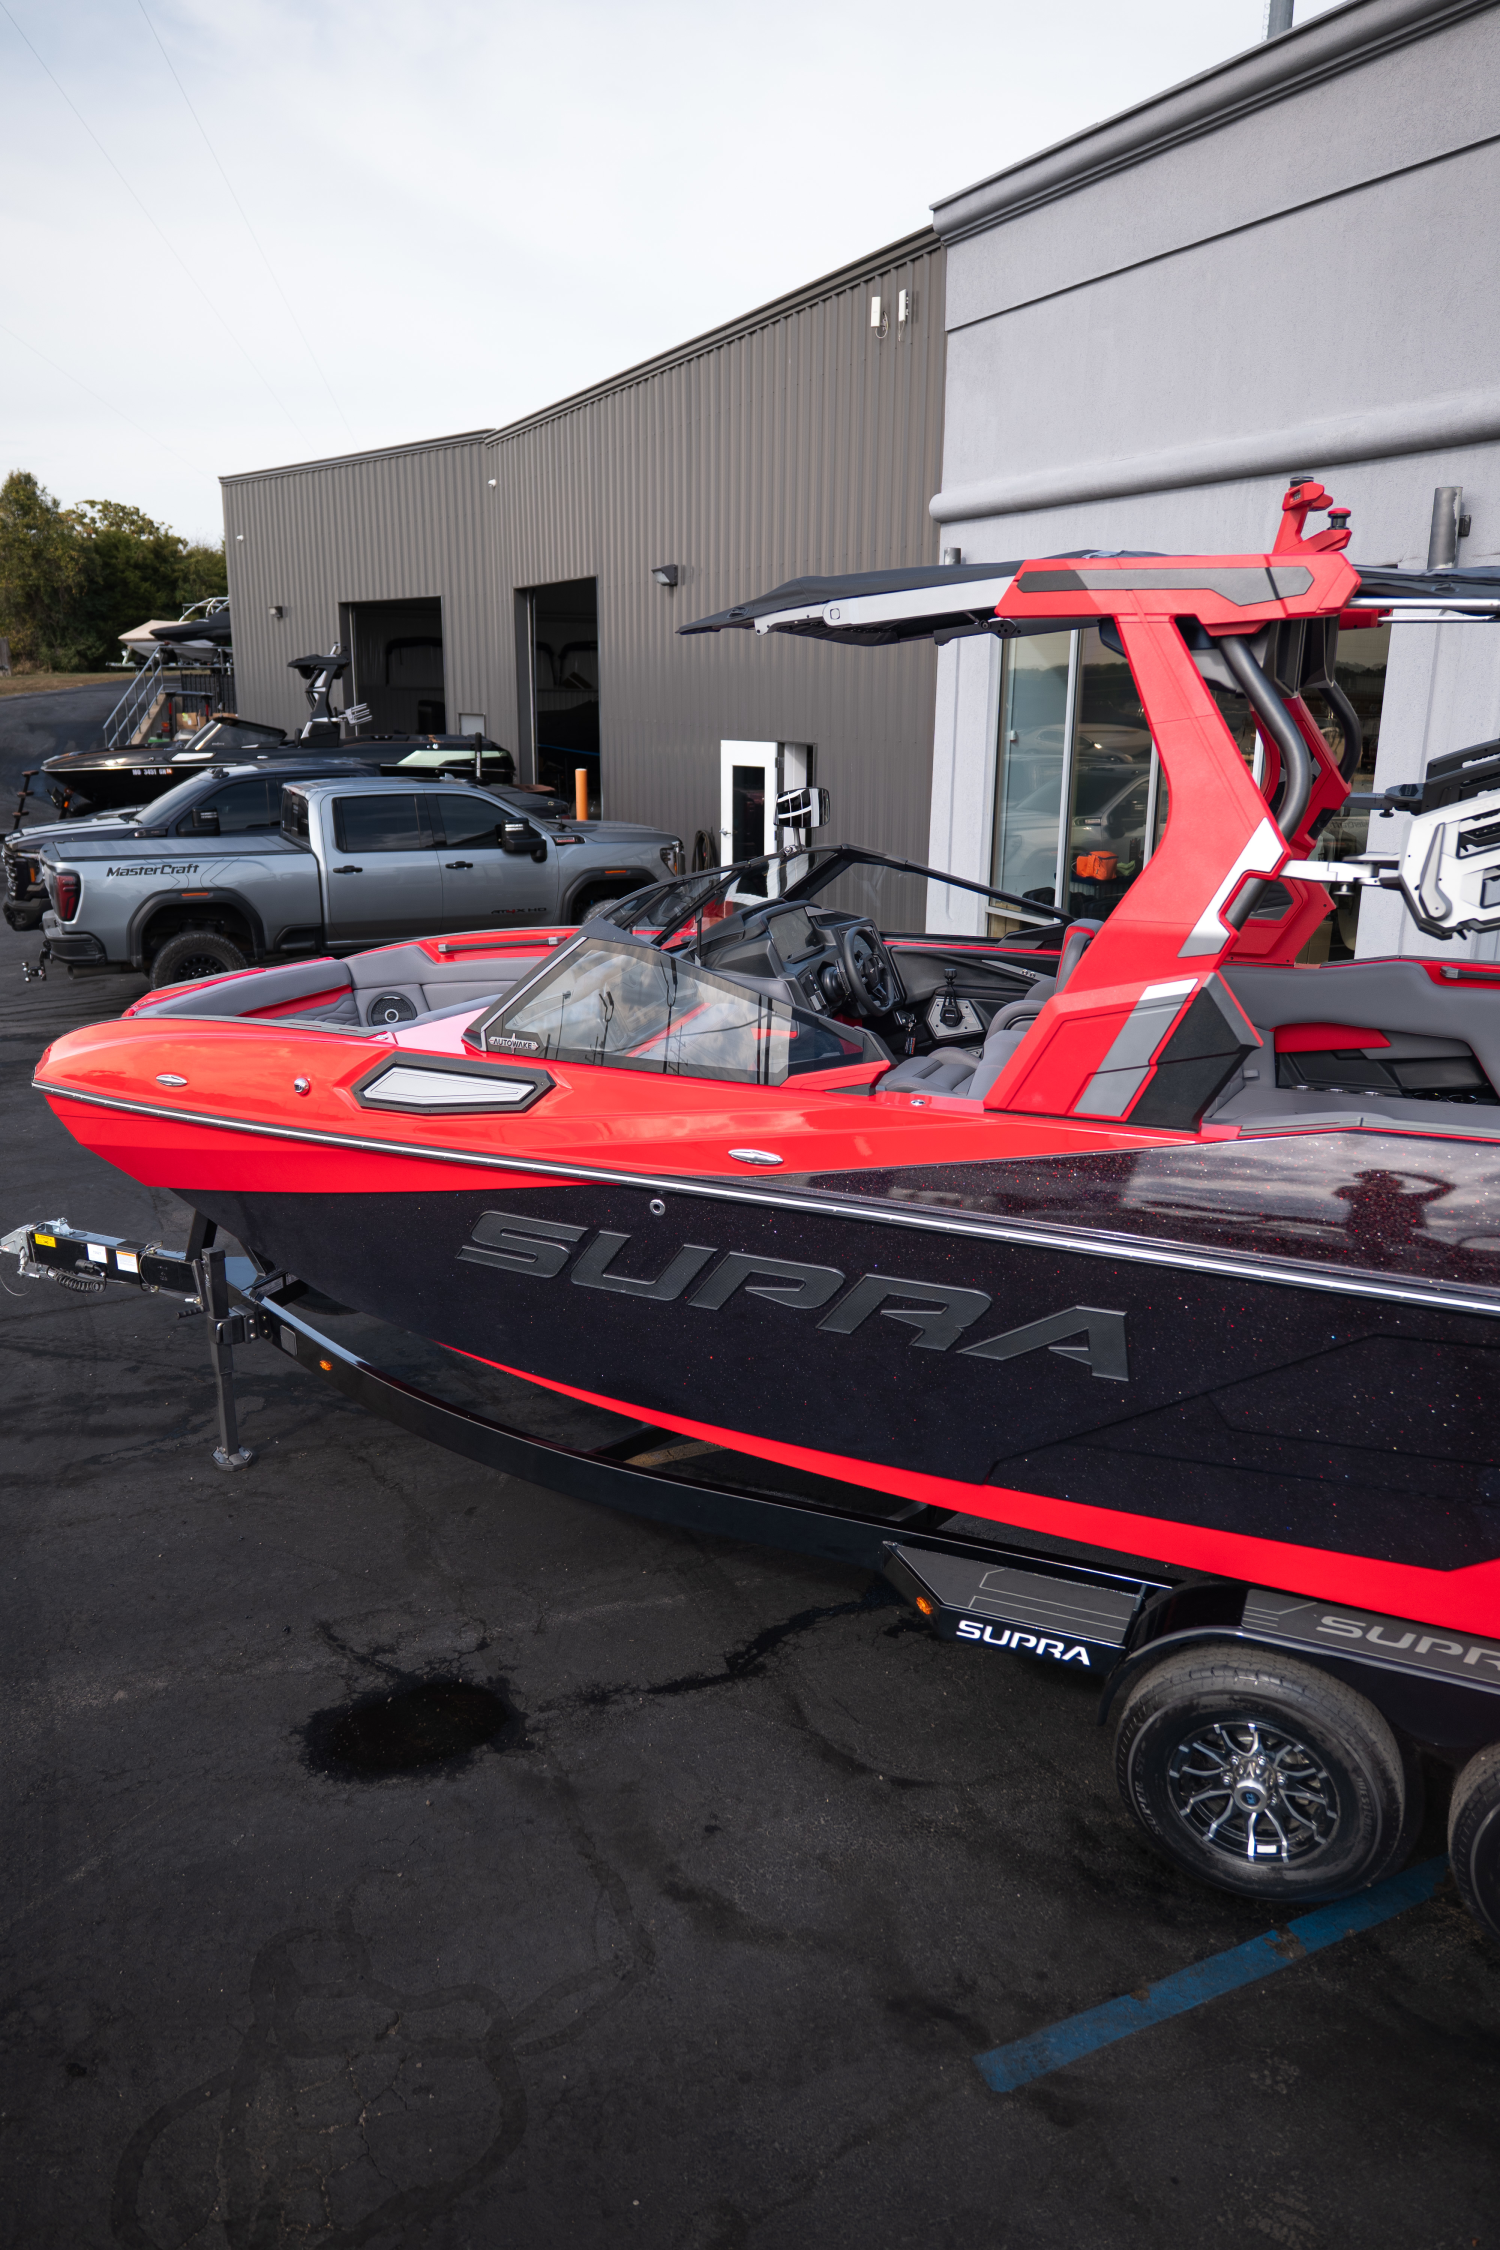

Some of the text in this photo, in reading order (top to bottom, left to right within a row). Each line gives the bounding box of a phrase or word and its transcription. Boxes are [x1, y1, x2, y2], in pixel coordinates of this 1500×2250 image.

[106, 864, 199, 877] MasterCraft
[493, 1038, 533, 1050] AUTOWAKE
[454, 1210, 1130, 1382] SUPRA
[956, 1619, 1091, 1666] SUPRA
[1316, 1615, 1500, 1672] SUPR
[1134, 1780, 1164, 1836] SUPER
